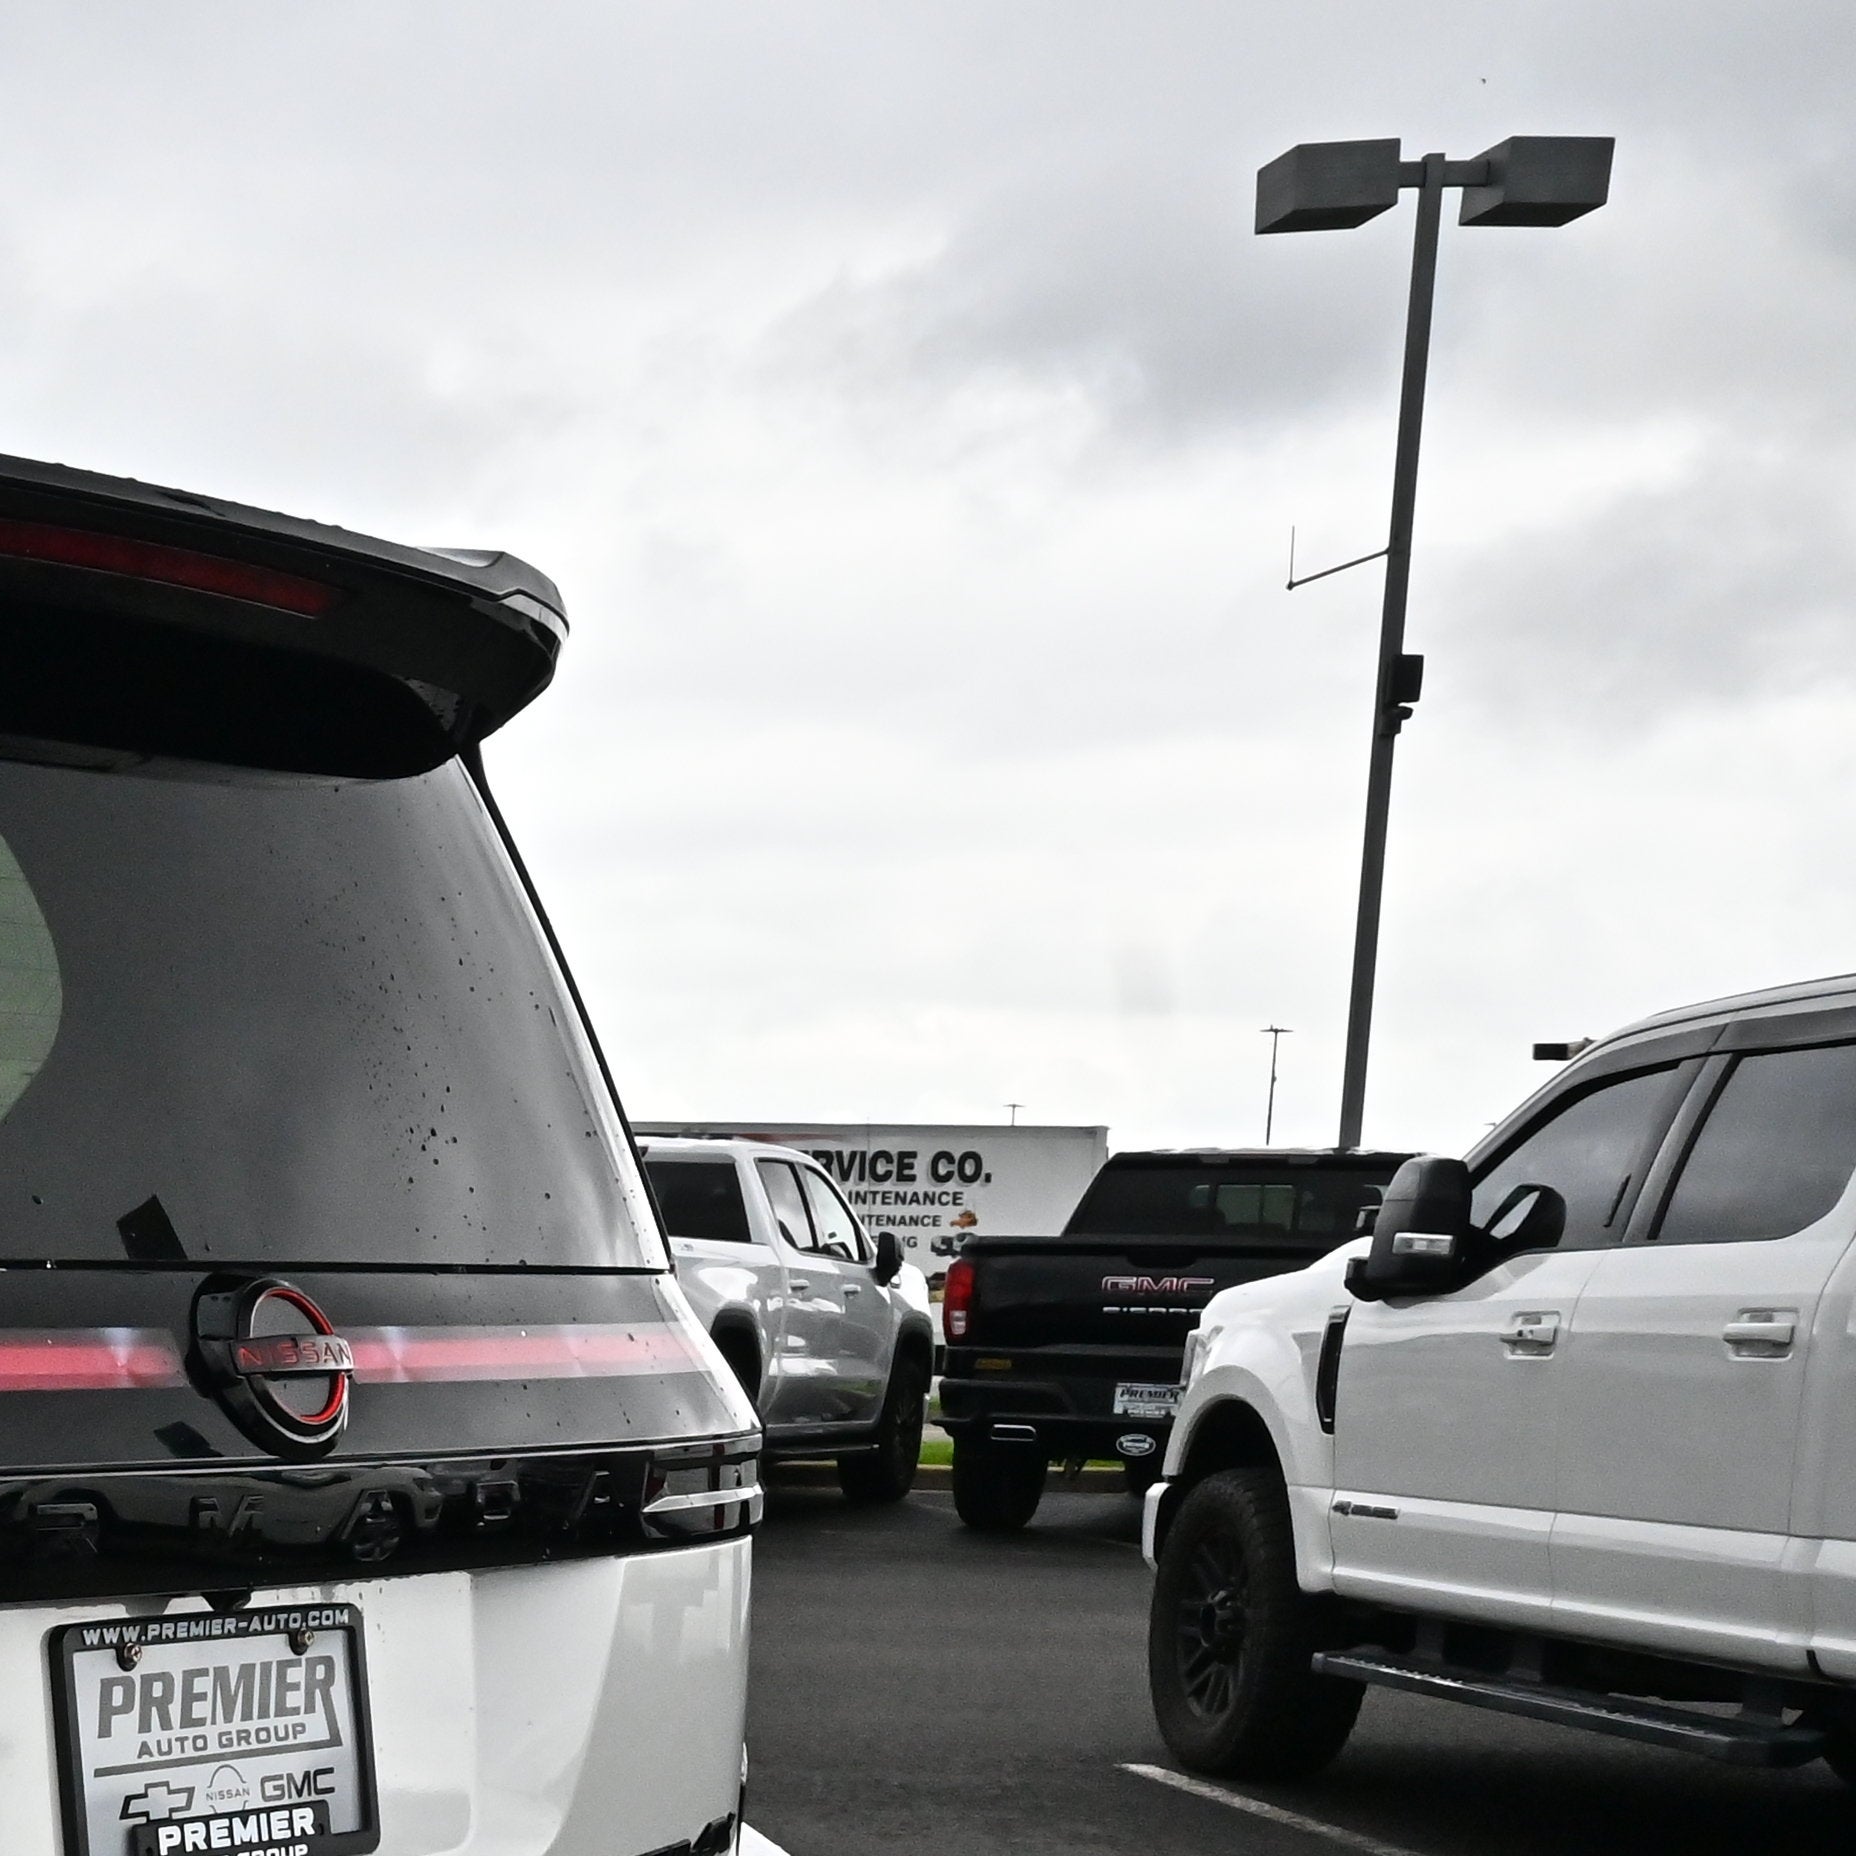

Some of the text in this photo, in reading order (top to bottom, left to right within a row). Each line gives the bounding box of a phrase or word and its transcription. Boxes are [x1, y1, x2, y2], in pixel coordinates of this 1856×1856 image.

[799, 1150, 992, 1183] RVICE CO.
[1101, 1276, 1215, 1297] GMC
[239, 1341, 353, 1367] NISSAN
[83, 1609, 349, 1646] WWW.PREMIER-AUTO.COM
[97, 1655, 343, 1741] PREMIER
[137, 1722, 308, 1759] AUTO GROUP
[205, 1767, 336, 1802] NISSAN GMC
[158, 1806, 315, 1856] PREMIER
